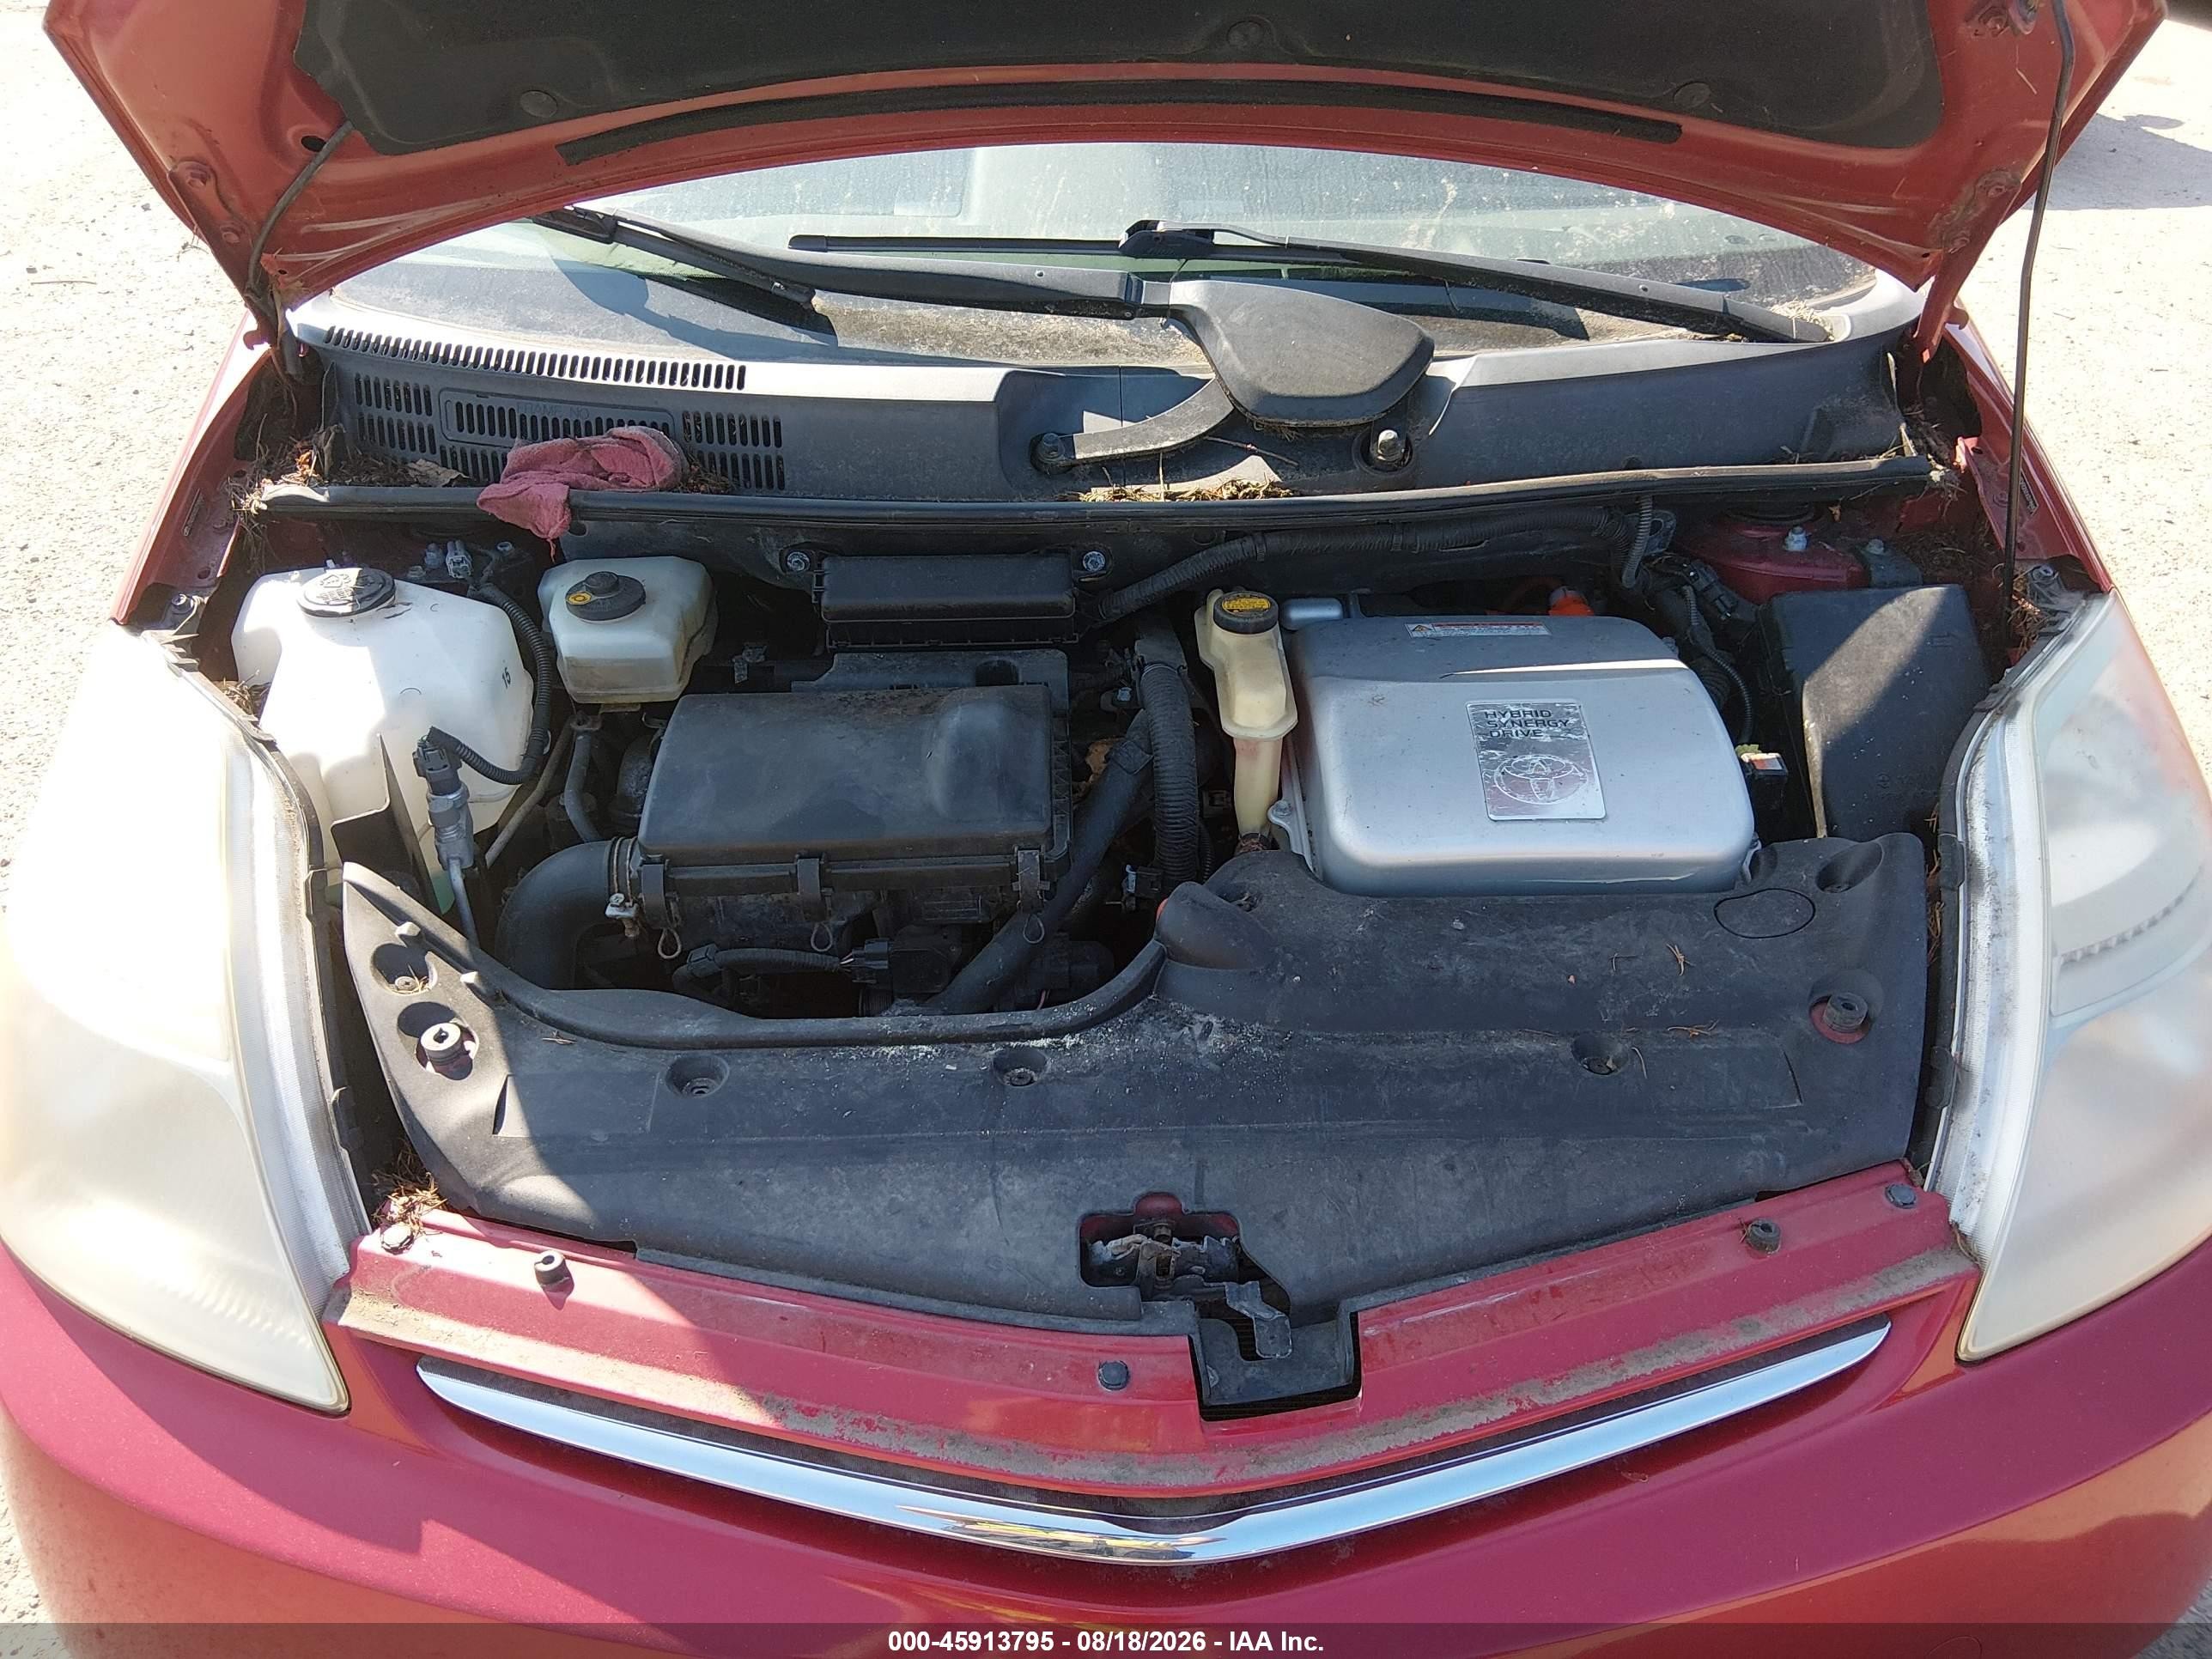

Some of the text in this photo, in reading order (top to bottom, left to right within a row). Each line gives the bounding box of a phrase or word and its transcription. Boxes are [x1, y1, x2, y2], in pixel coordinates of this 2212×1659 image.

[501, 666, 511, 690] 15
[1484, 709, 1553, 720] HYBRID
[1486, 719, 1571, 729] SYNERGY
[1490, 729, 1545, 738] DRIVE
